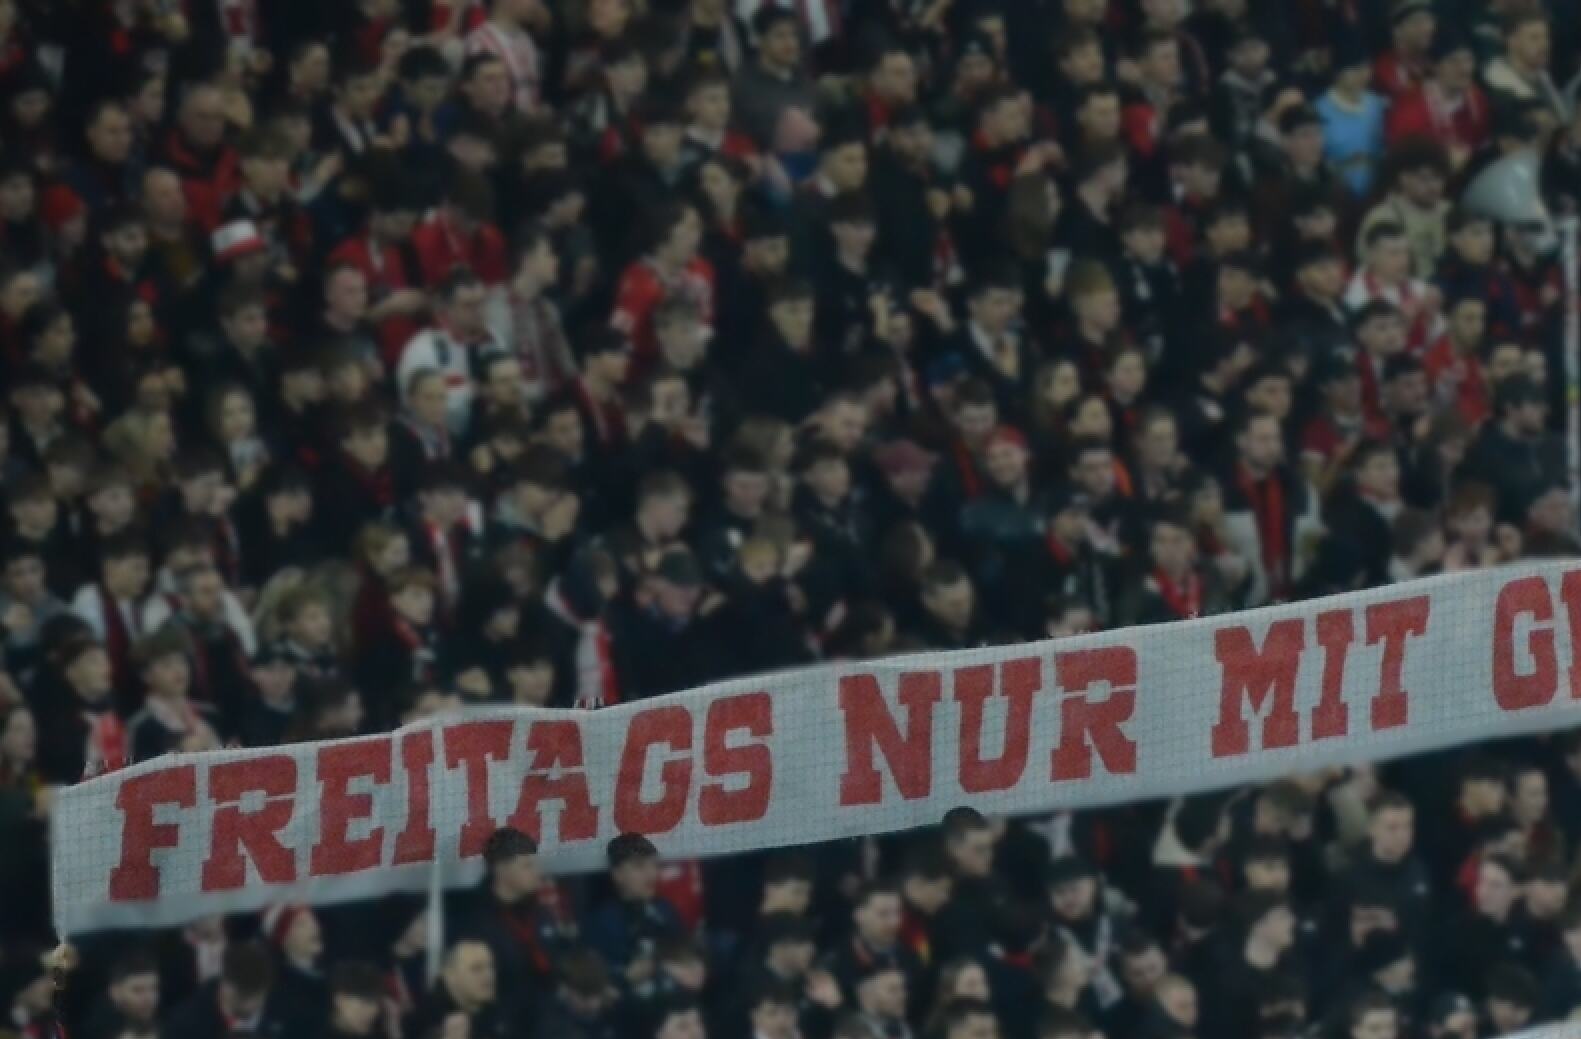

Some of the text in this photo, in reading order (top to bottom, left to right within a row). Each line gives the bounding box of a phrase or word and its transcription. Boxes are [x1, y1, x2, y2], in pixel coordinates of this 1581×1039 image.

[109, 692, 773, 902] FREITAGS
[839, 645, 1139, 807] NUR
[1211, 595, 1431, 758] MIT
